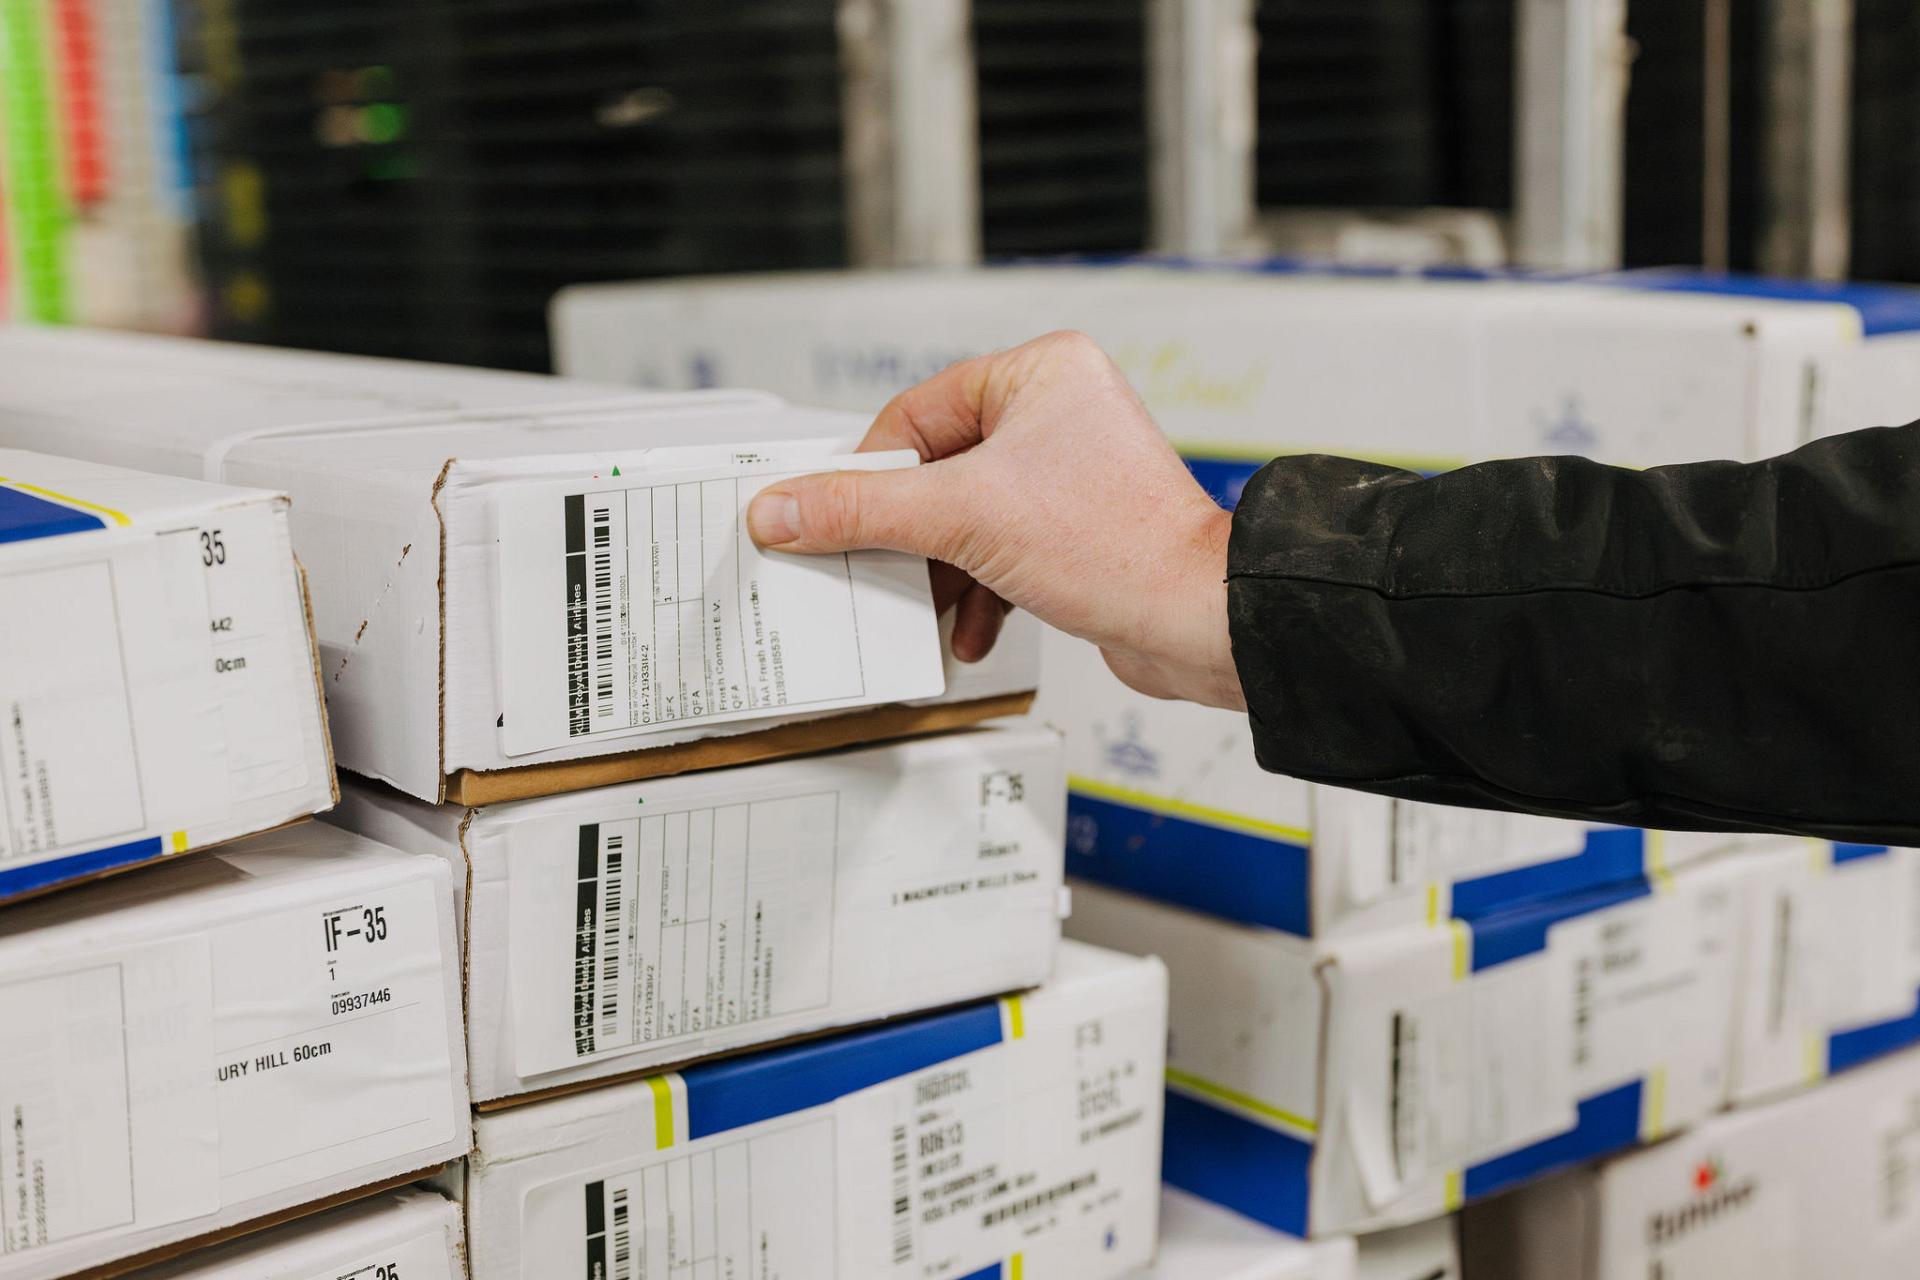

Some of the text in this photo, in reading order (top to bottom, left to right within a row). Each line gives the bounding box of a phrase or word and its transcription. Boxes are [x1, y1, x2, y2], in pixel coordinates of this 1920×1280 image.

[573, 583, 585, 736] KLM Royal Dutch Airlines
[714, 626, 724, 675] Connect
[691, 690, 703, 716] QFA
[717, 677, 727, 711] Fresh
[580, 908, 592, 953] Airlines
[329, 967, 336, 982] 1
[580, 956, 591, 991] Dutch
[331, 987, 392, 1016] 09937446
[580, 992, 592, 1026] Royal
[255, 1051, 289, 1073] HILL
[293, 1042, 332, 1063] 60cm
